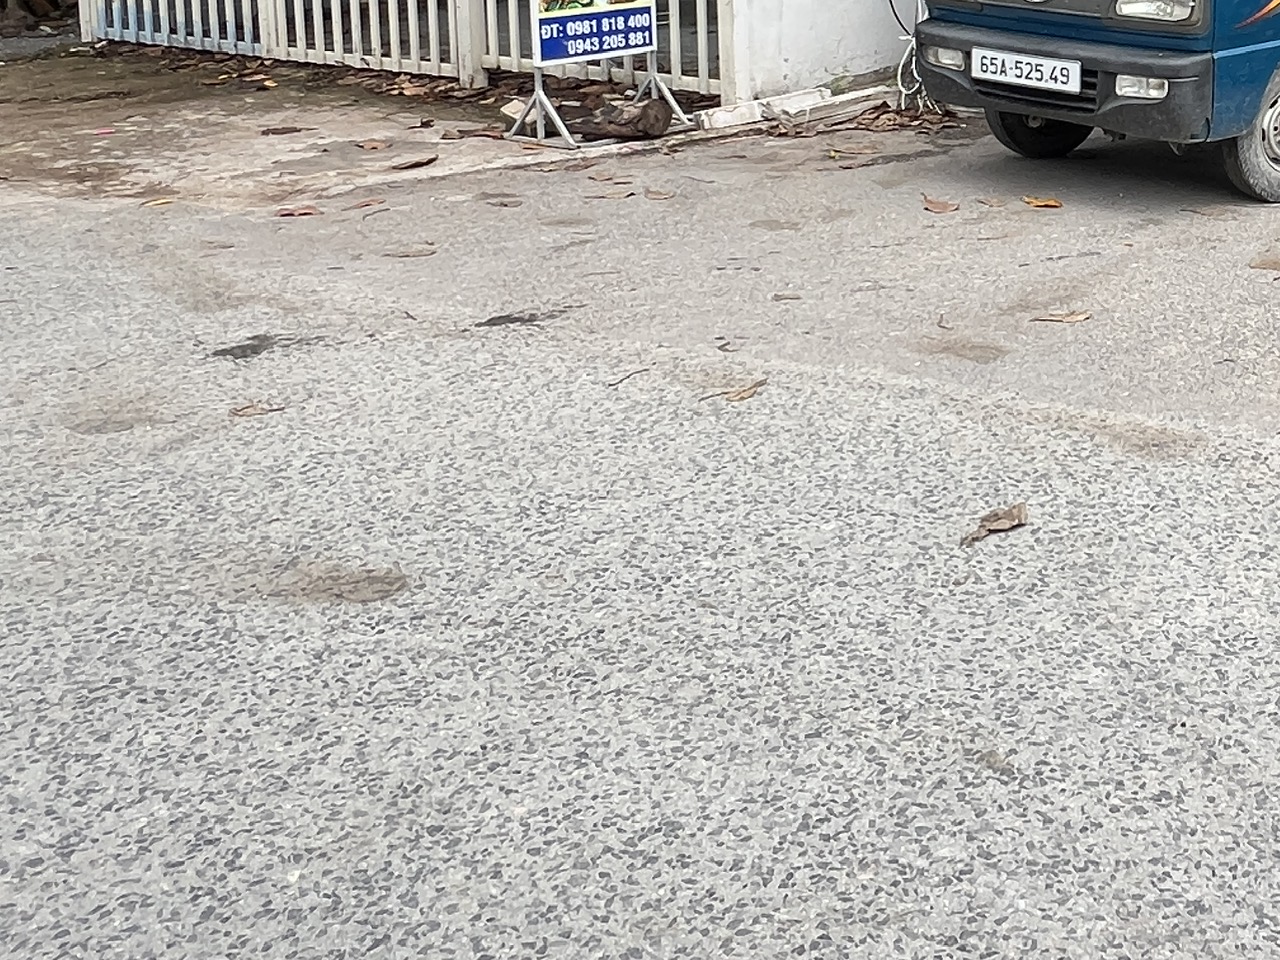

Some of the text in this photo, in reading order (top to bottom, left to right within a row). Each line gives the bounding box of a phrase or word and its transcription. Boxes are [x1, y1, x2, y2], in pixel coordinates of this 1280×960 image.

[541, 13, 650, 39] ĐT: 0981 818 400
[567, 30, 650, 55] 0943 205 881
[980, 55, 1071, 85] 65A-525.49
